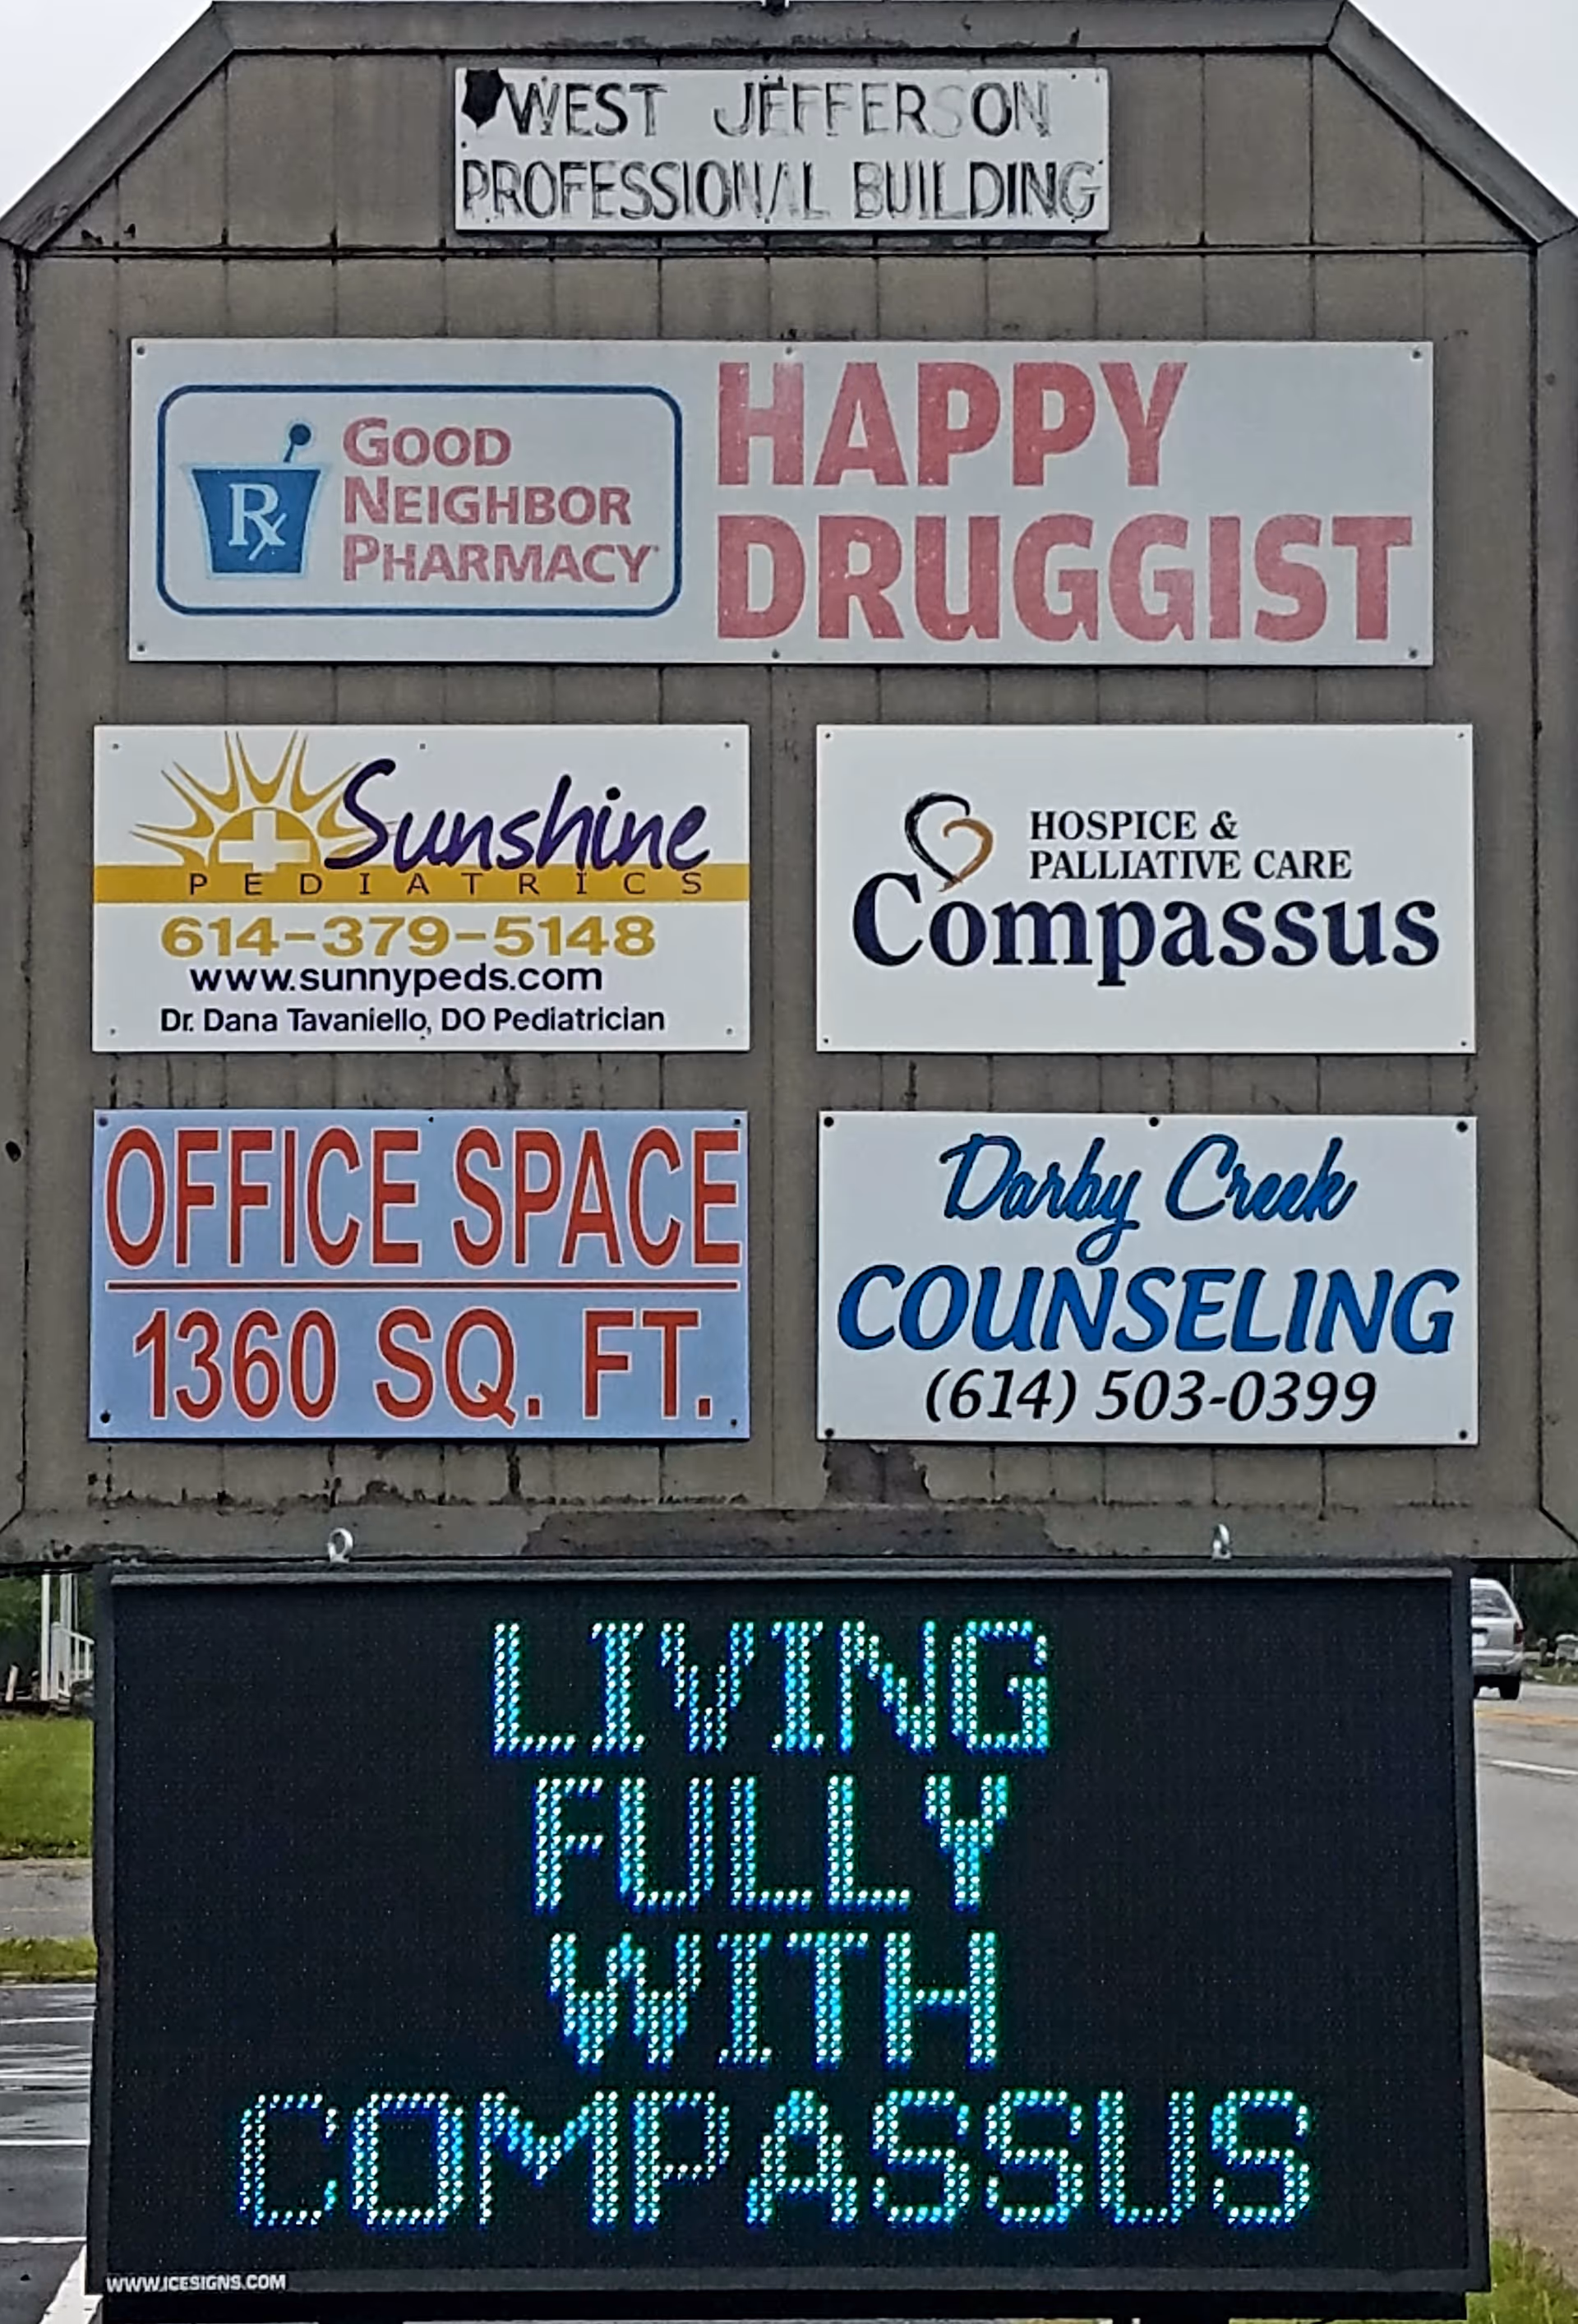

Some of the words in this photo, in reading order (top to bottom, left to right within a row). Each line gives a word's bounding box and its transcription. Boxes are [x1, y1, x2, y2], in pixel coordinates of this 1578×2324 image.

[501, 81, 667, 137] WEST
[714, 79, 1052, 138] JEFFERSON
[462, 159, 829, 220] PROFESSIONAL
[853, 159, 1102, 222] BUILDING
[342, 417, 511, 468] GOOD
[717, 361, 1188, 487] HAPPY
[342, 475, 631, 526] NEIGHBOR
[342, 534, 653, 584] PHARMACY
[717, 513, 1414, 642] DRUGGIST
[324, 758, 711, 874] Sunshine
[1029, 809, 1197, 842] HOSPICE
[1209, 810, 1239, 842] &
[189, 870, 704, 896] PEDIATRICS
[1029, 849, 1241, 880] PALLIATIVE
[1253, 848, 1353, 880] CARE
[159, 914, 657, 959] 614-379-5148
[851, 871, 1441, 987] Compassus
[189, 963, 603, 998] www.sunnypeds.com
[160, 1008, 194, 1033] Dr.
[205, 1008, 279, 1033] Dana
[287, 1007, 431, 1037] Tavaniello,
[441, 1008, 483, 1033] DO
[494, 1005, 666, 1033] Pediatrician
[104, 1126, 422, 1269] OFFICE
[452, 1126, 742, 1268] SPACE
[939, 1133, 1142, 1266] Darby
[1164, 1133, 1359, 1222] Creek
[836, 1264, 1461, 1355] COUNSELING
[132, 1307, 338, 1422] 1360
[374, 1305, 542, 1429] SQ.
[582, 1308, 714, 1421] FT.
[925, 1367, 1077, 1424] (614)
[1095, 1368, 1377, 1424] 503-0399
[492, 1618, 1050, 1755] LIVING
[533, 1774, 1009, 1914] FULLY
[547, 1931, 999, 2070] WITH
[238, 2089, 1313, 2226] COMPASSUS
[106, 2274, 286, 2293] WWW.ICESIGNS.COM
